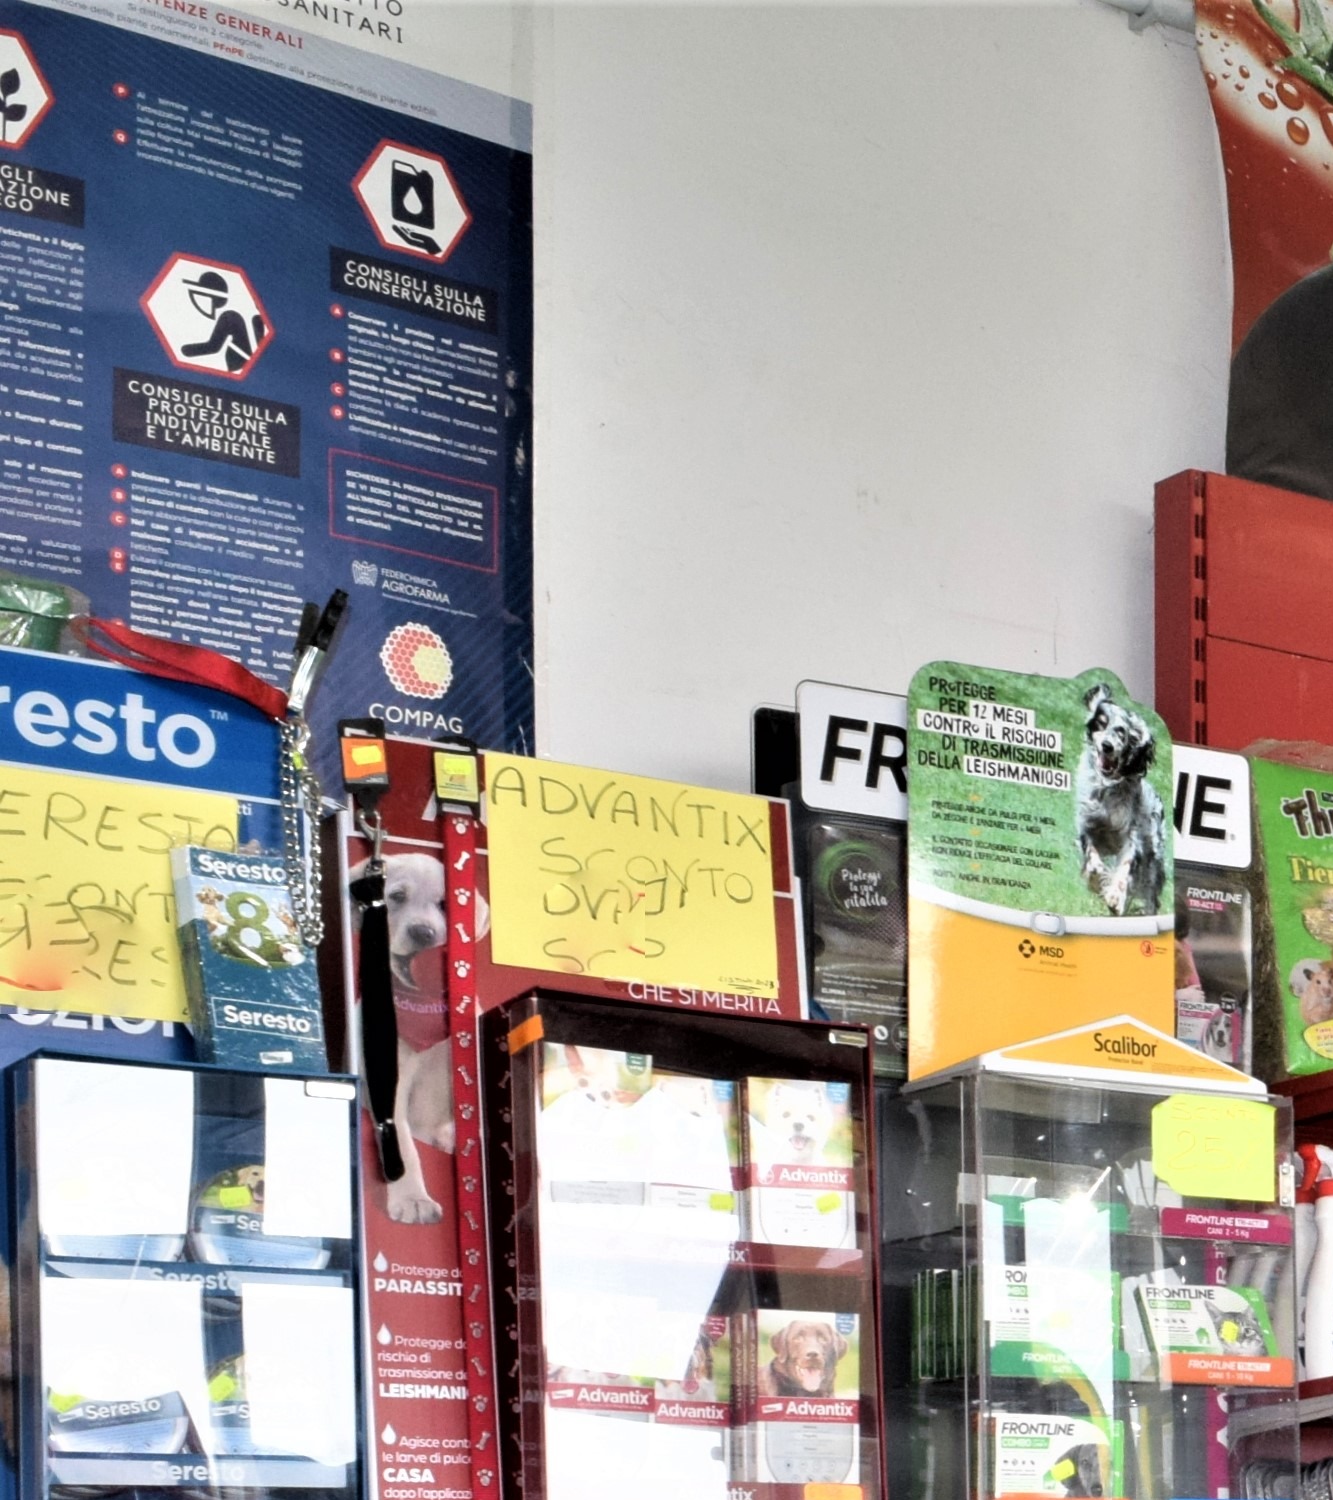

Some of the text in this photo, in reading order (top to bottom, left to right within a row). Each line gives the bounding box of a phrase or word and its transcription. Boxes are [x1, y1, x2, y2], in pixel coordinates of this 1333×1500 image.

[215, 12, 304, 49] GENERALI
[345, 259, 484, 308] CONSIGLI SULLA
[343, 273, 487, 322] CONSERVAZIONE
[128, 380, 288, 426] CONSIGLI SULLA
[148, 398, 268, 435] PROTEZIONE
[145, 411, 272, 450] INDIVIDUALE
[146, 425, 276, 464] E L'AMBIENTE
[382, 580, 450, 605] AGROFARMA
[368, 703, 464, 735] COMPAG
[938, 696, 1029, 726] PER 12 MESI
[0, 686, 216, 769] esto
[1002, 727, 1057, 749] RISCHIO
[962, 737, 1065, 769] TRASMISSIONE
[917, 749, 1069, 788] DELLA LEISHMANIOSI
[490, 765, 767, 856] ADVANTIX
[198, 854, 287, 884] Seresto
[1186, 886, 1243, 905] FRONTLINE
[1039, 944, 1065, 959] MSD
[628, 981, 673, 1001] CHE
[702, 990, 782, 1016] MERITA
[223, 1004, 312, 1034] Seresto
[1093, 1033, 1158, 1058] Scalibor
[779, 1167, 848, 1184] Advantix
[1185, 1213, 1234, 1227] FRONTLINE
[391, 1263, 446, 1279] Protegge
[1145, 1287, 1215, 1301] FRONTLINE
[378, 1351, 431, 1364] rischio di
[378, 1367, 454, 1381] trasmissione
[379, 1383, 469, 1400] LEISHMANI
[577, 1387, 650, 1407] Advantix
[85, 1396, 161, 1420] Seresto
[785, 1400, 855, 1418] Advantix
[1001, 1422, 1075, 1436] FRONTLINE
[399, 1435, 440, 1450] Agisce
[395, 1452, 428, 1464] larve
[429, 1452, 441, 1464] di
[151, 1460, 245, 1484] Seresto
[383, 1468, 435, 1483] CASA
